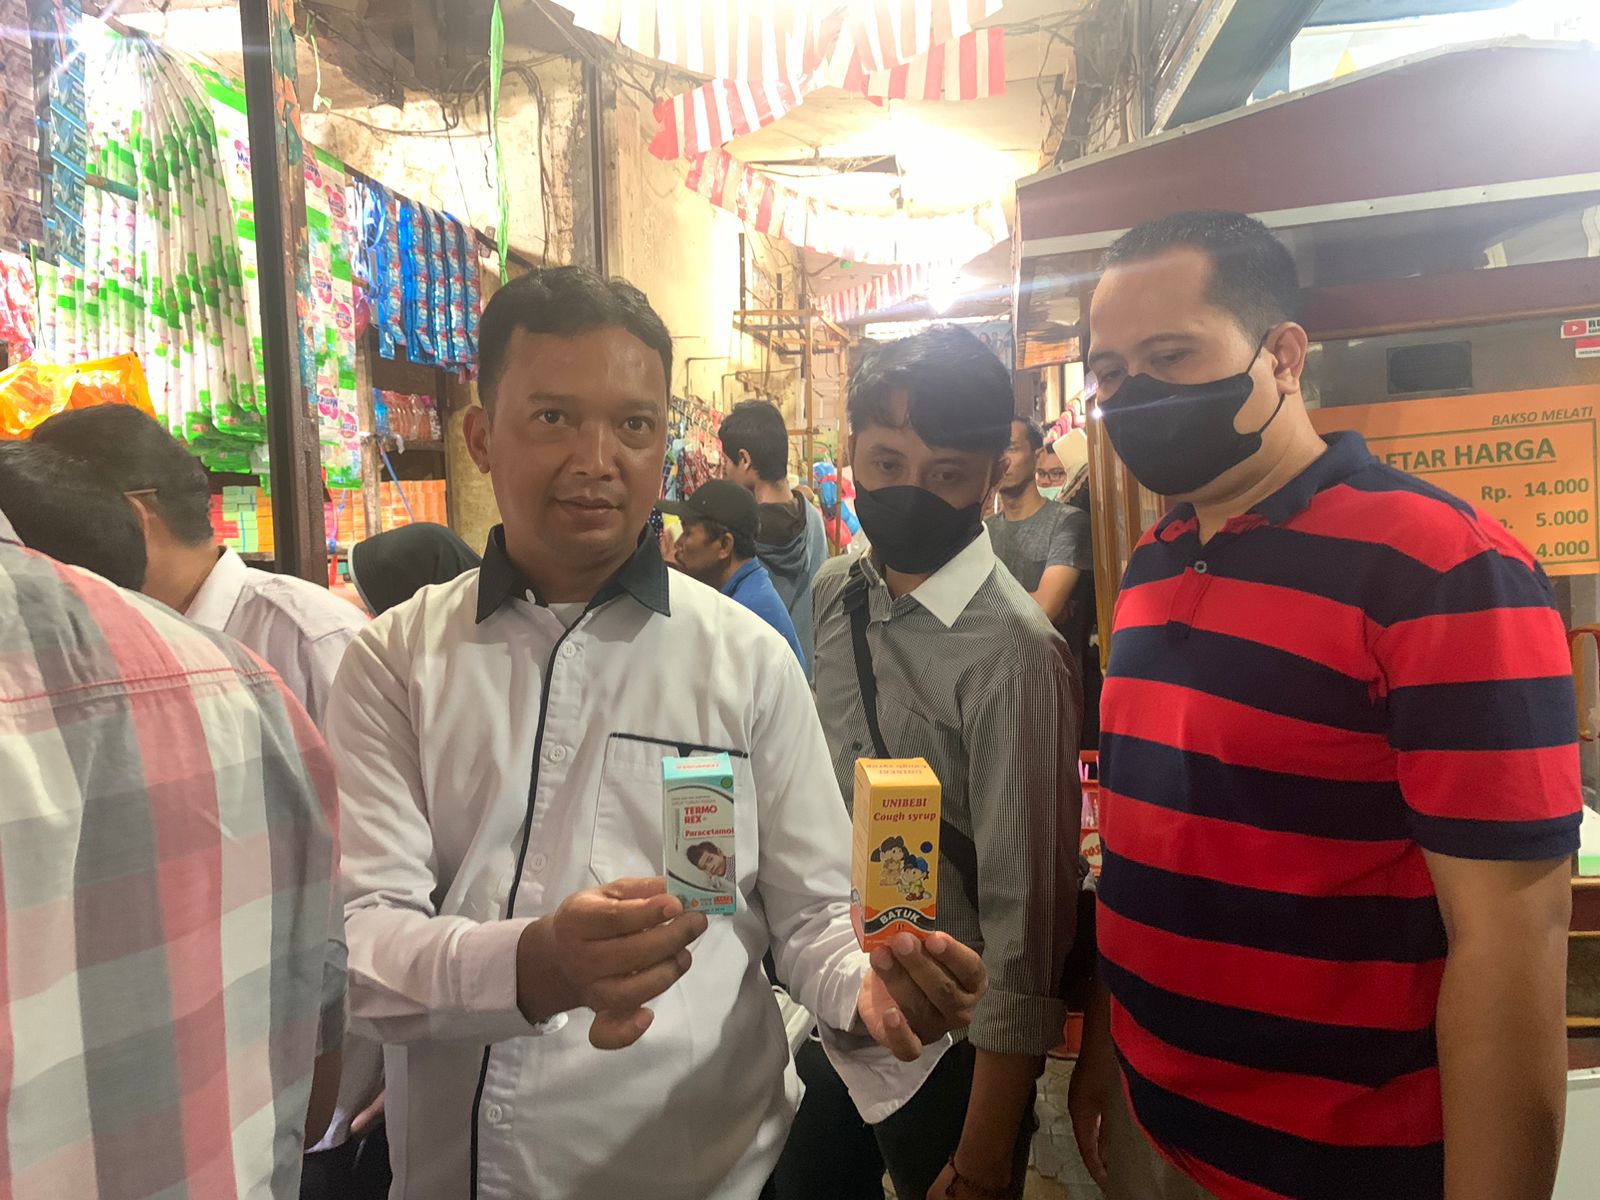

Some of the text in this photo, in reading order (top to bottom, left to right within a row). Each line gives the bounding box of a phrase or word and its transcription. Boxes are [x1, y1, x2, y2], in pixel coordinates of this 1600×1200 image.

[1491, 406, 1594, 426] BAKSO MELATI
[1376, 437, 1556, 471] FTAR HARGA
[1481, 478, 1589, 503] Rp. 14.000
[1536, 509, 1589, 527] 5.000
[1536, 540, 1590, 558] 4.000
[684, 804, 718, 816] TERMO
[882, 797, 928, 808] UNIBEBI
[684, 815, 702, 825] REX
[873, 811, 937, 822] Cough syrup
[685, 827, 735, 838] Paracetamol
[879, 908, 921, 926] BATUK
